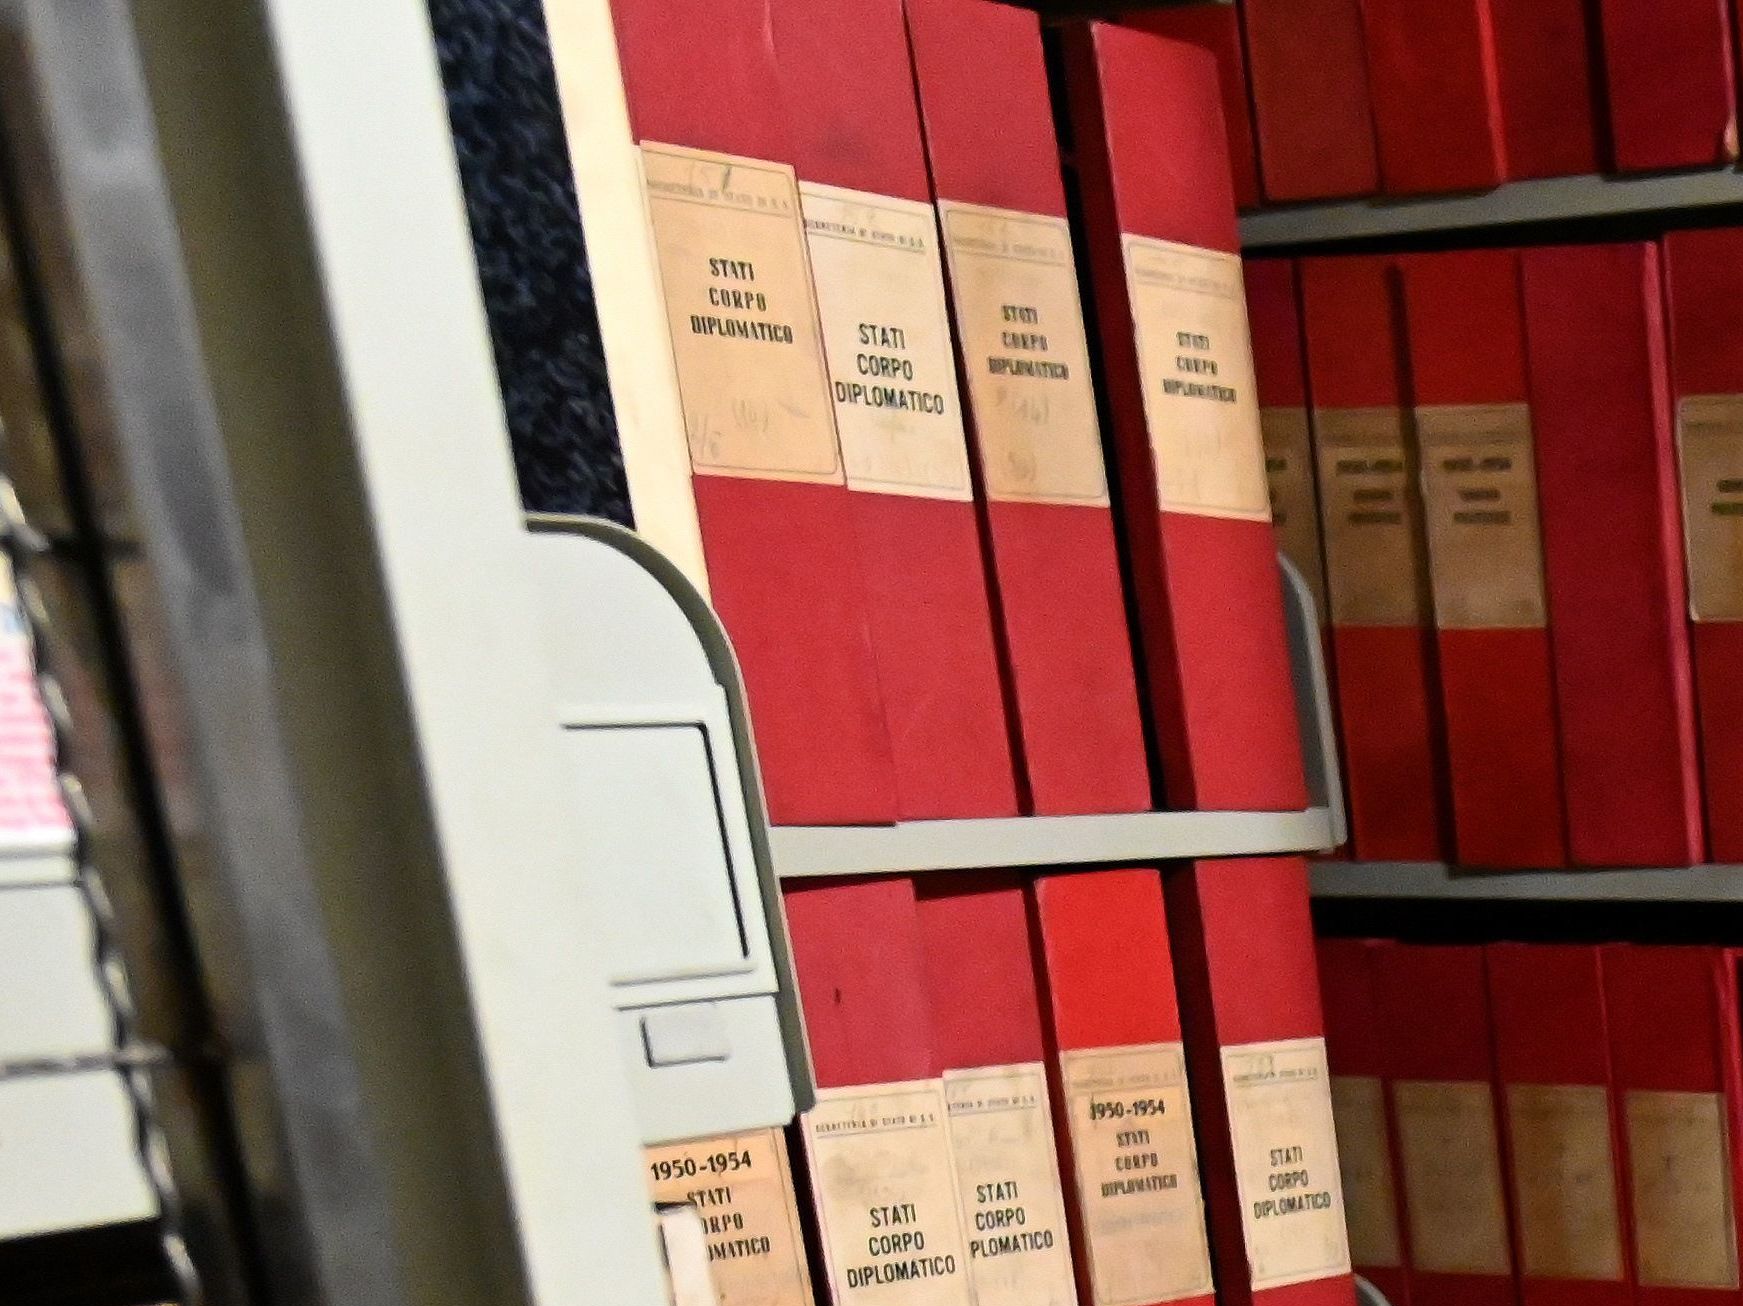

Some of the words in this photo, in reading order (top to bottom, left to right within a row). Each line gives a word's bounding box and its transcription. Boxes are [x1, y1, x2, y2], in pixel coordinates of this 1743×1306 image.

[709, 257, 755, 282] STATI
[708, 287, 767, 312] CORPO
[1001, 304, 1038, 325] STATI
[690, 314, 793, 344] DIPLOMATICO
[858, 322, 906, 350] STATI
[1002, 331, 1048, 352] CORPO
[856, 353, 914, 382] CORPO
[988, 356, 1070, 381] DIPLOMATICO
[1175, 355, 1218, 377] CORPO
[834, 381, 945, 415] DIPLOMATICO
[1089, 1098, 1166, 1121] 1950-1954
[1115, 1130, 1151, 1148] STATI
[650, 1150, 751, 1181] 1950-1954
[1114, 1152, 1159, 1172] CORPO
[1270, 1146, 1303, 1167] STATI
[976, 1180, 1019, 1204] STATI
[1101, 1173, 1178, 1198] DIPLOMATICO
[1268, 1169, 1309, 1193] CORPO
[869, 1203, 917, 1228] STATI
[1253, 1191, 1332, 1220] DIPLOMATICO
[700, 1210, 744, 1235] ORPO
[975, 1206, 1026, 1231] CORPO
[868, 1231, 925, 1257] CORPO
[968, 1230, 1055, 1259] PLOMATICO
[847, 1255, 956, 1288] DIPLOMATICO
